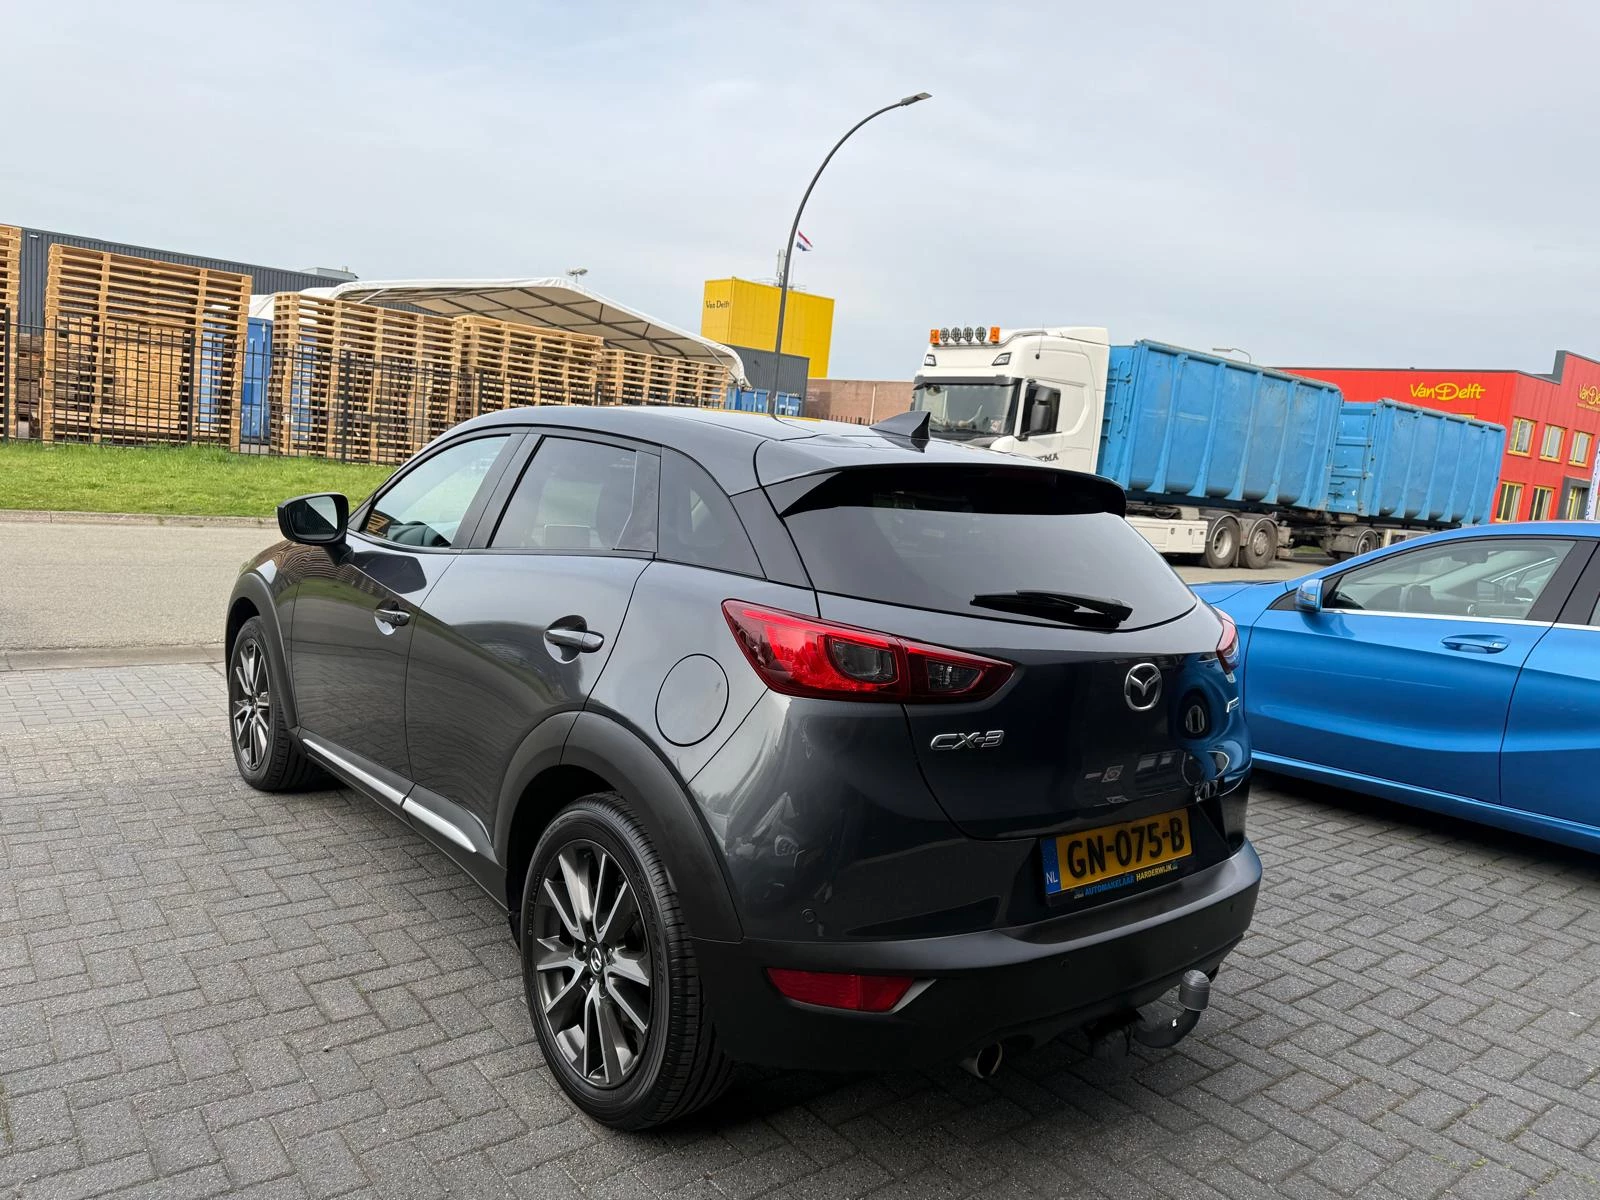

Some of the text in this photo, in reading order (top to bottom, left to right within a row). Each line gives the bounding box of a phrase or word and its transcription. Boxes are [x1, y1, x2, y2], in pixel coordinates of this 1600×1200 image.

[930, 730, 1005, 751] CX-3
[1067, 817, 1185, 879] GN-075-B
[1045, 871, 1059, 885] NL
